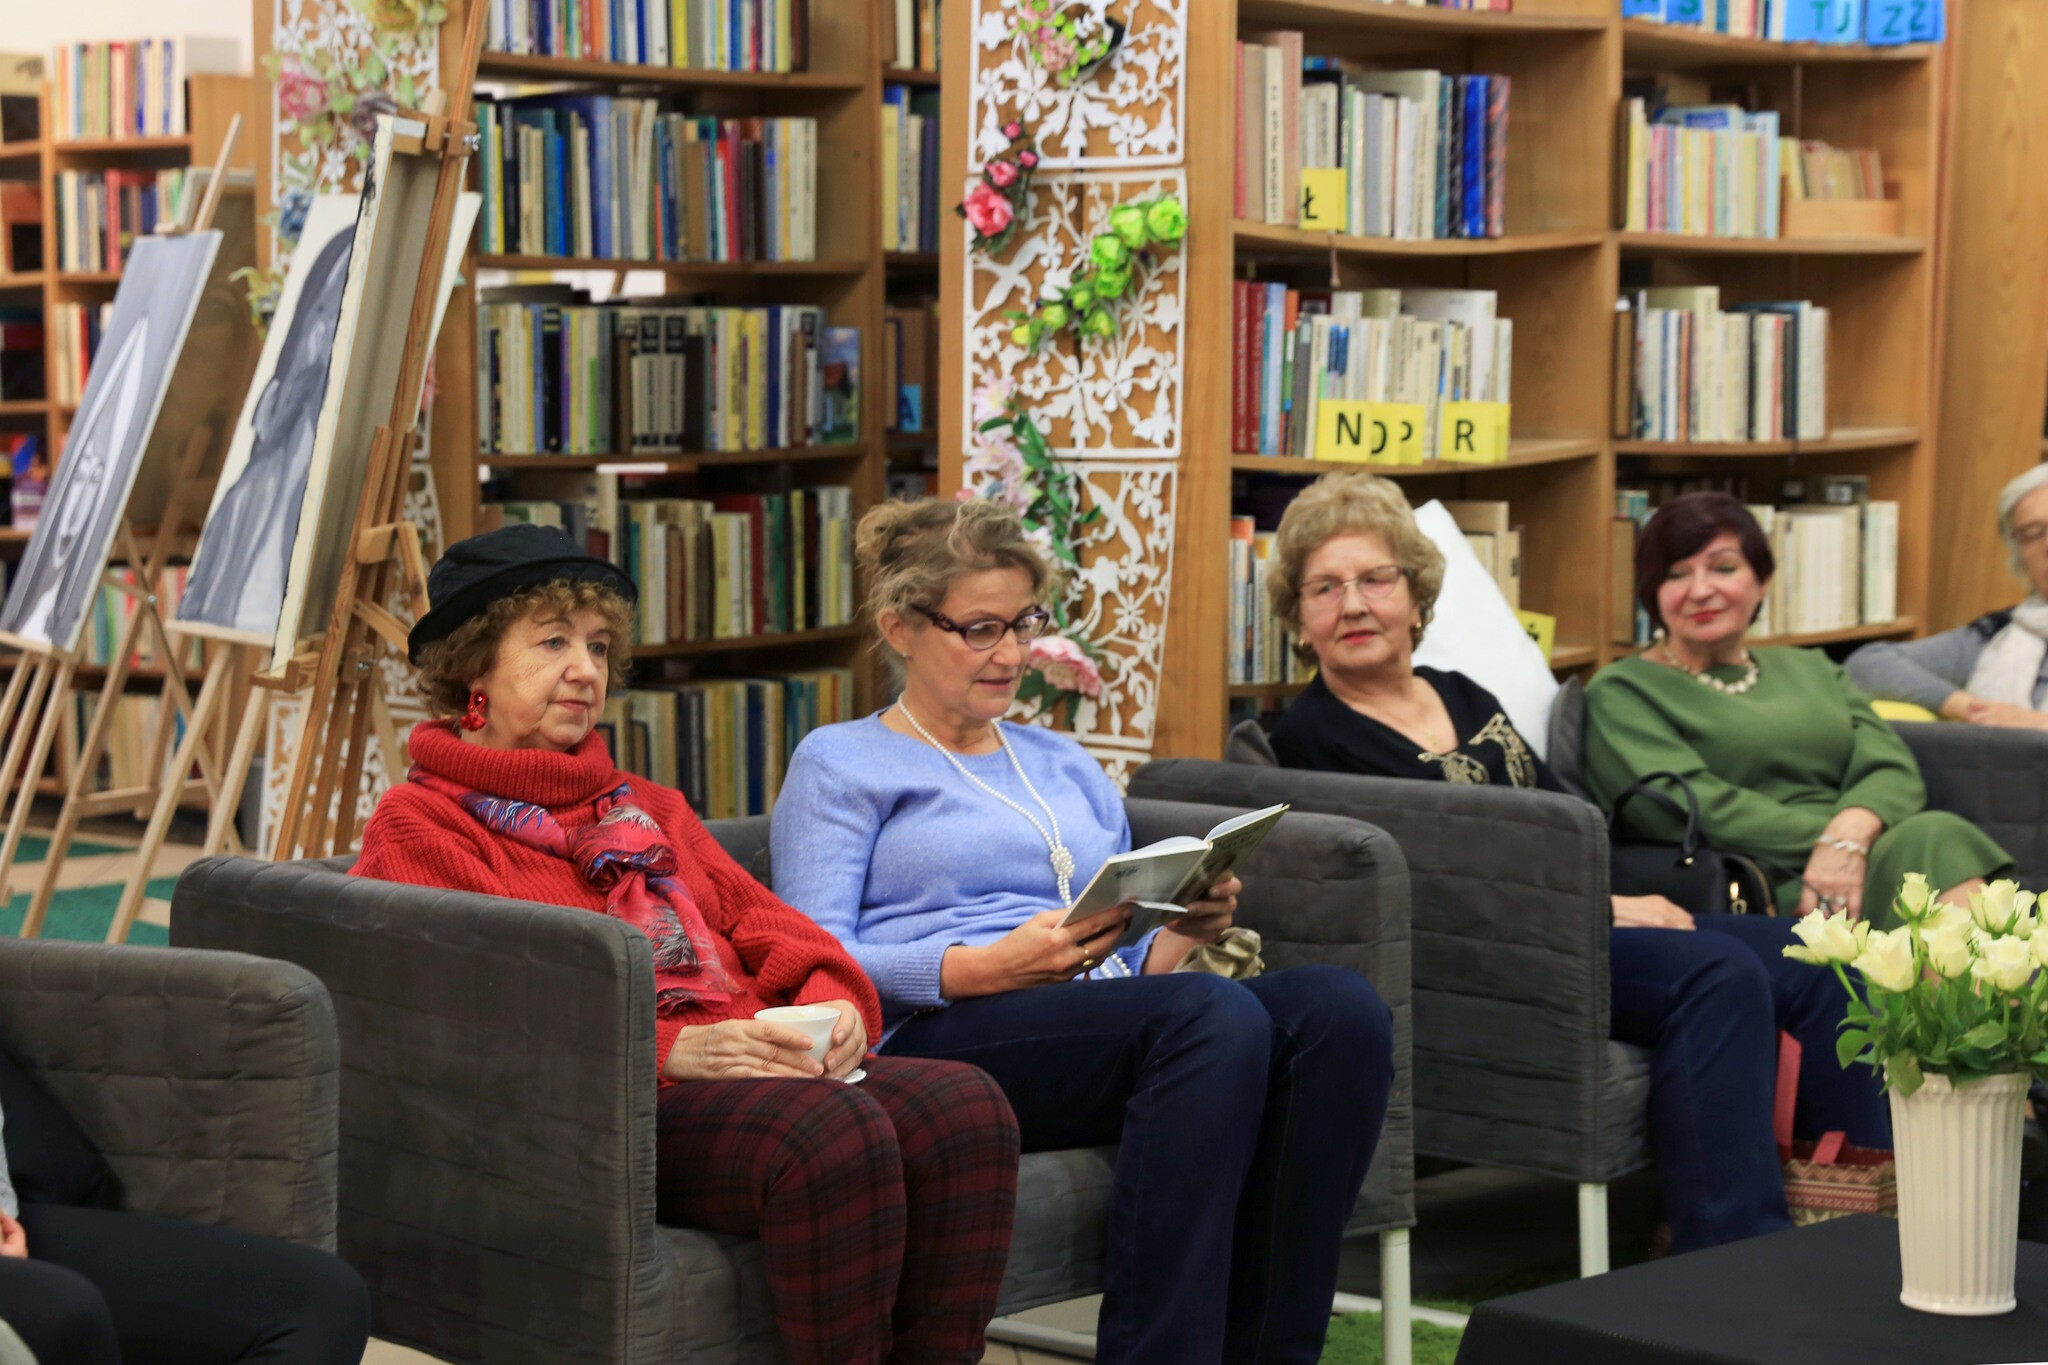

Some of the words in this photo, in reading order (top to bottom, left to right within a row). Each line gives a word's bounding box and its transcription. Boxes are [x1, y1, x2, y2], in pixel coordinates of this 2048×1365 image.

[1810, 0, 1829, 32] T
[1883, 5, 1903, 36] Z
[1301, 186, 1319, 220] Ł
[1336, 412, 1362, 446] N
[1455, 419, 1475, 452] R
